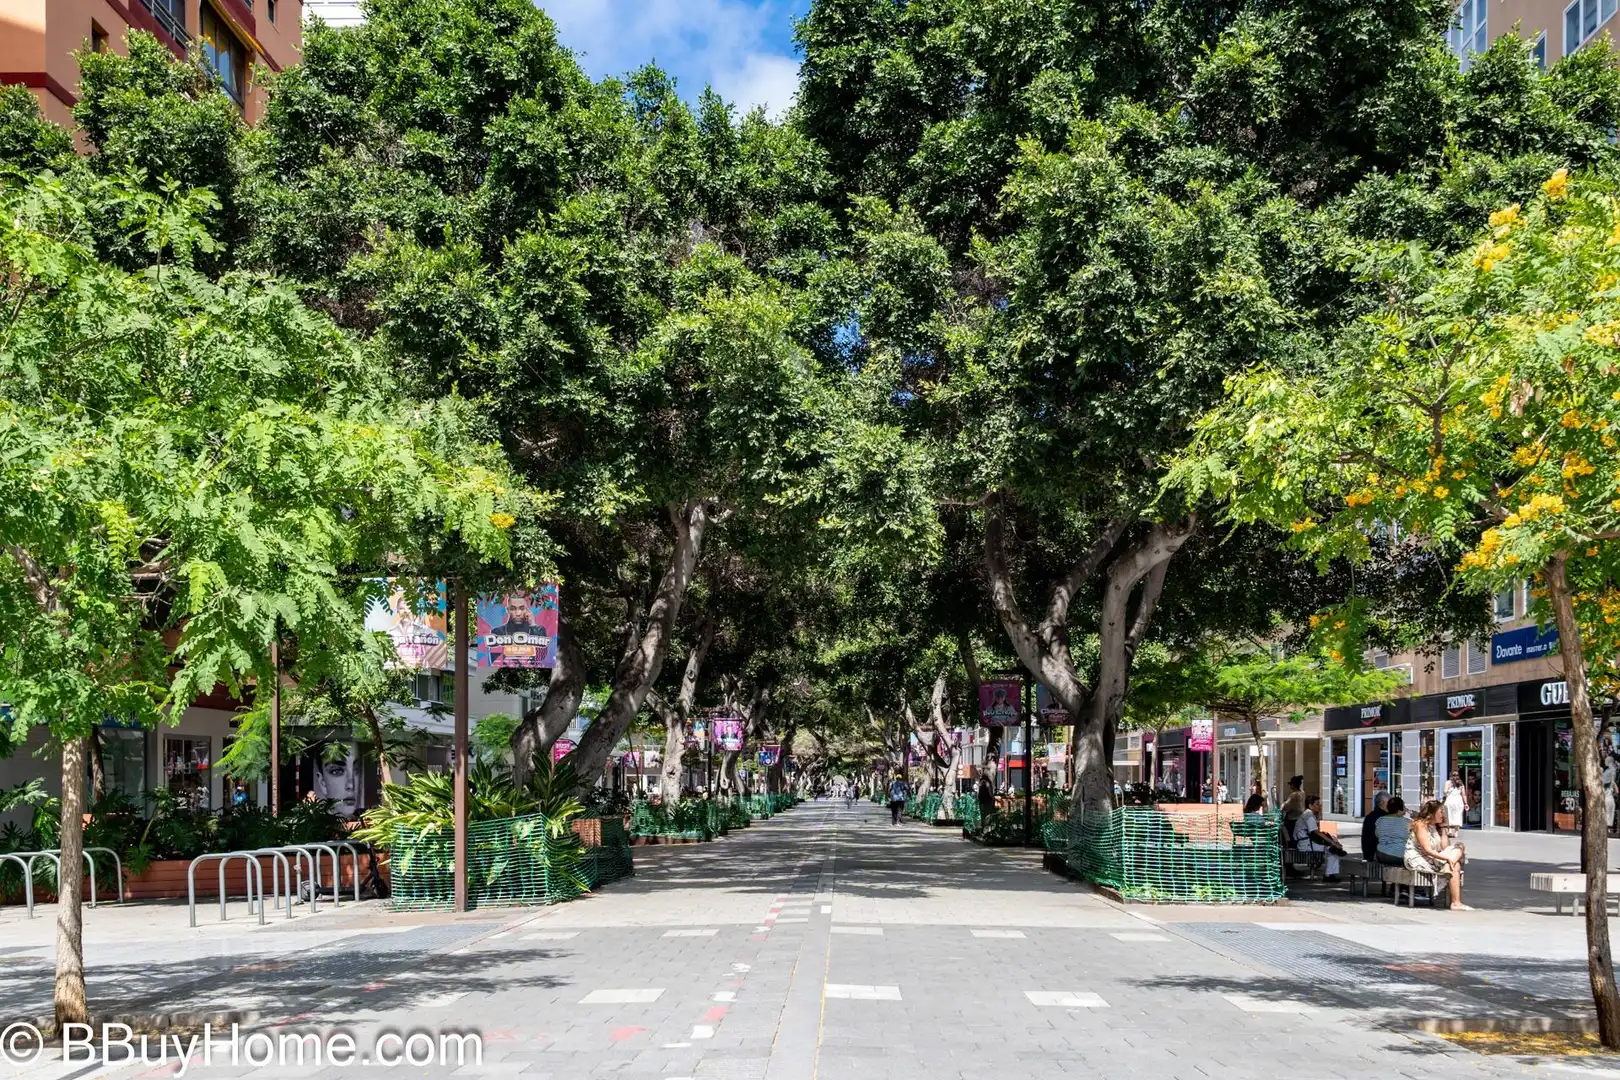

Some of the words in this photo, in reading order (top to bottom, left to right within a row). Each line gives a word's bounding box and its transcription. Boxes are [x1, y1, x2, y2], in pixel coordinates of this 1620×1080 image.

[486, 634, 512, 646] Don
[513, 632, 550, 646] Omar
[1496, 643, 1523, 658] Davante
[1447, 694, 1475, 709] PRIMOR
